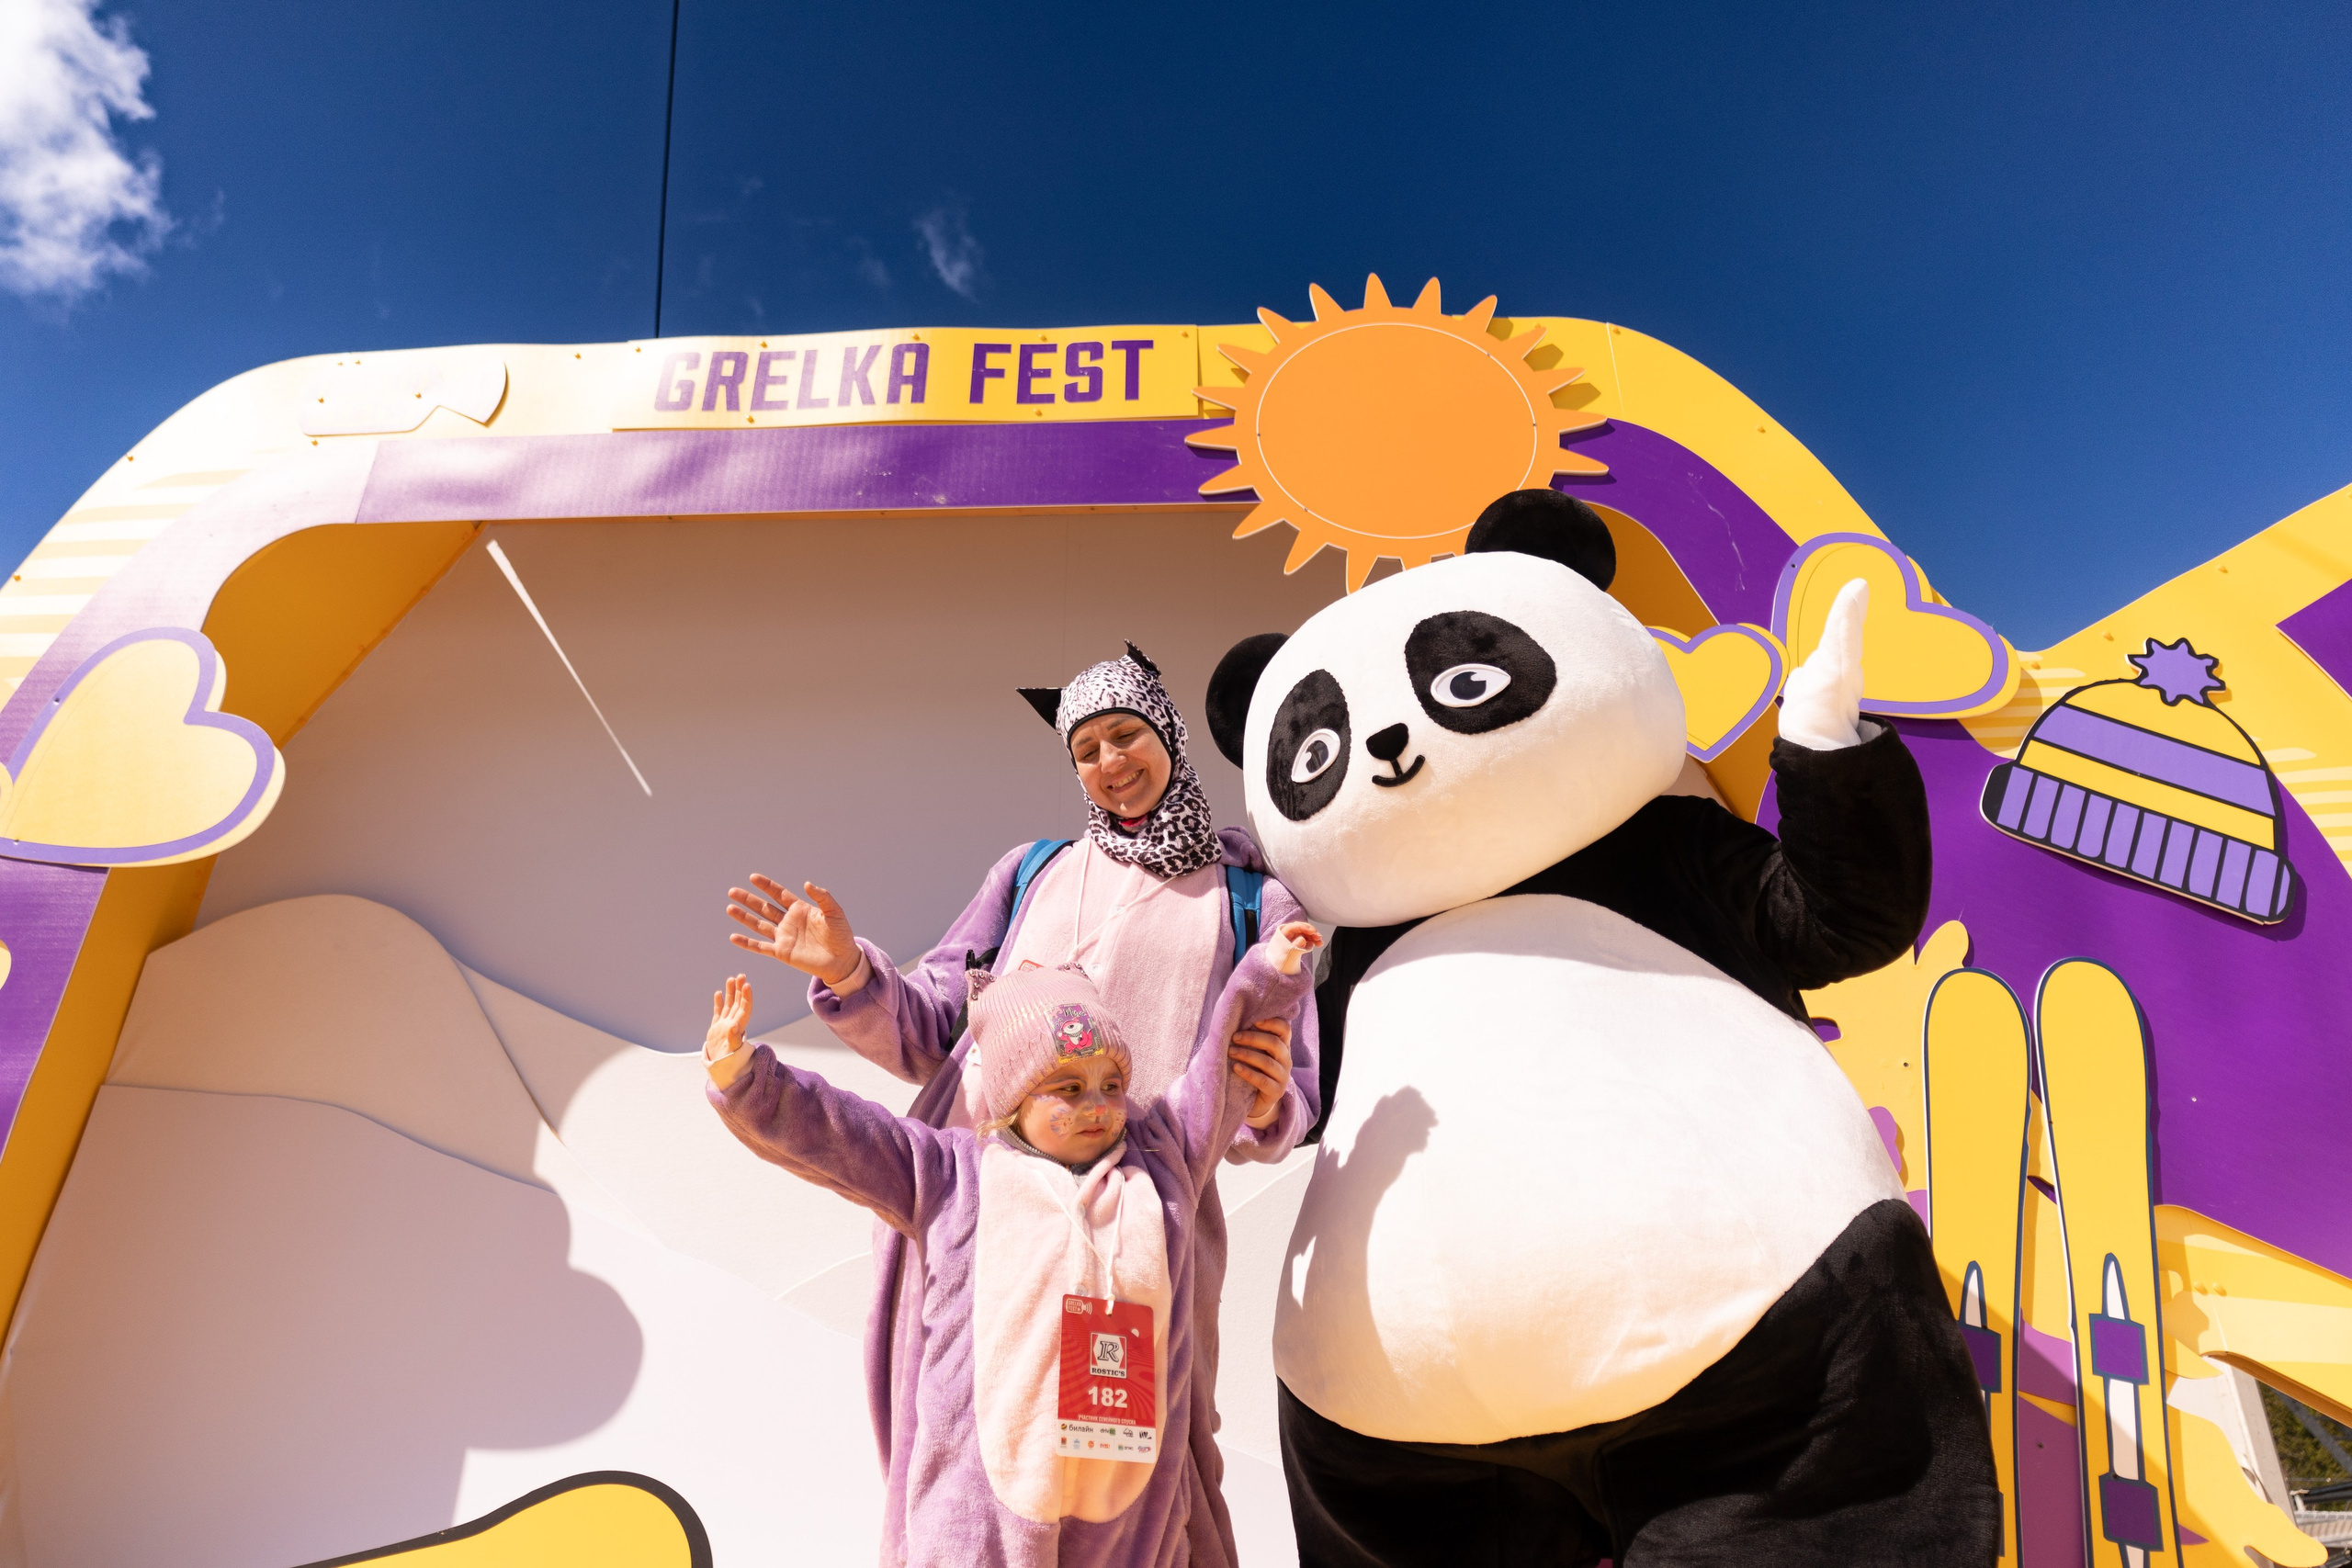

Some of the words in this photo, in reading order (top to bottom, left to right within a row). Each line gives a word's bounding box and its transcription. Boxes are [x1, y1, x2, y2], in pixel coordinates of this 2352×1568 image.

[653, 343, 930, 412] GRELKA
[969, 340, 1154, 405] FEST
[1097, 1340, 1120, 1363] R
[1091, 1367, 1125, 1377] ROSTIC'S
[1088, 1386, 1128, 1408] 182
[1069, 1424, 1094, 1433] билайн
